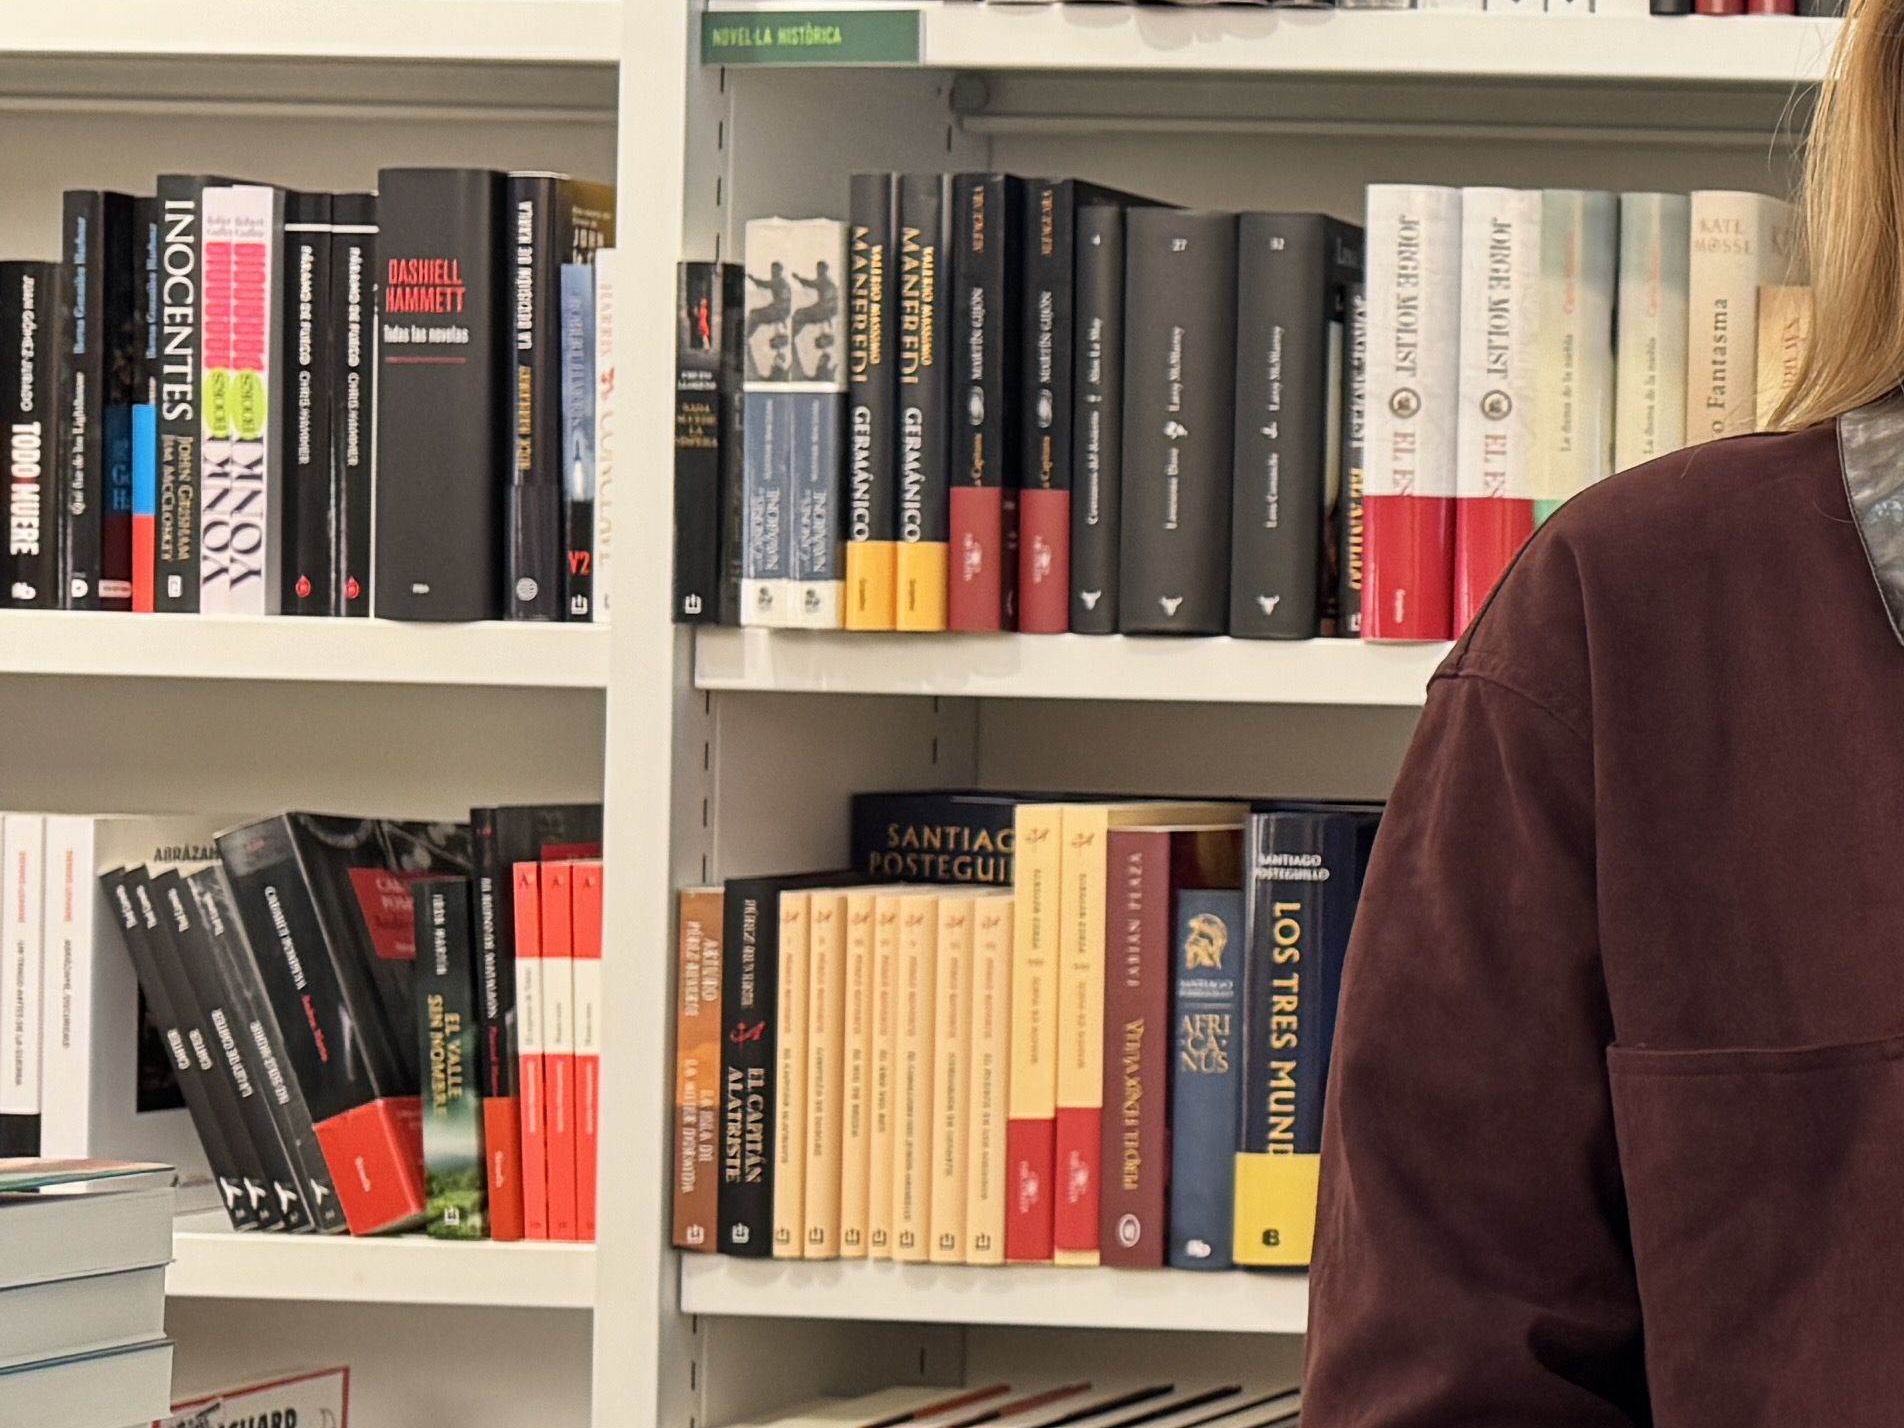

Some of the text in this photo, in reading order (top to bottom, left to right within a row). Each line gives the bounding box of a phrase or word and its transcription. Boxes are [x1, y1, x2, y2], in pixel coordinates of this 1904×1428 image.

[161, 199, 197, 422] INOCENTES
[385, 286, 466, 315] HAMMETT
[387, 258, 463, 287] DASHIELL
[851, 226, 869, 385] MANFREDI
[1705, 298, 1729, 410] Fantasma
[852, 405, 871, 542] GERMÁNICO
[886, 825, 1016, 850] SANTIAG
[1271, 901, 1301, 1052] LOS TRES
